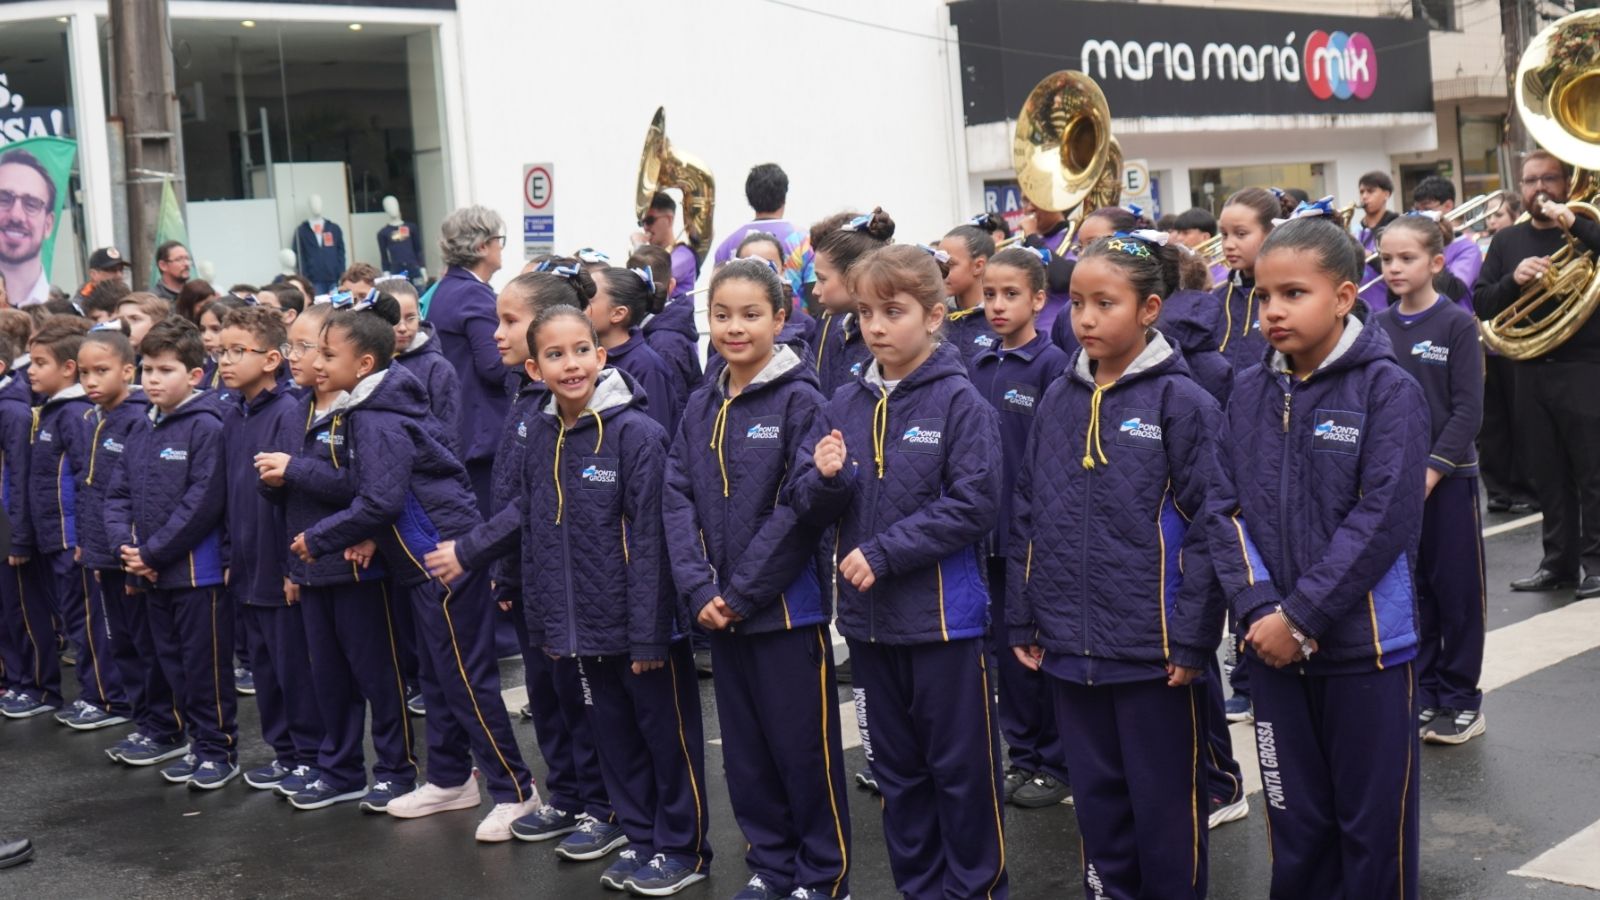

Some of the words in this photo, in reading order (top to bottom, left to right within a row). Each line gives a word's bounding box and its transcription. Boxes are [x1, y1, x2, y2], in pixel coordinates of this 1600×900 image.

[1081, 40, 1196, 81] maria
[1203, 31, 1300, 82] mariá
[1313, 45, 1369, 82] mix
[1127, 170, 1139, 189] E
[533, 176, 544, 200] E
[986, 189, 1023, 213] RA
[1429, 345, 1449, 355] PONTA
[1421, 352, 1447, 361] GROSSA
[917, 430, 941, 438] PONTA
[1129, 429, 1162, 440] GROSSA
[1331, 425, 1360, 437] PONTA
[909, 436, 939, 444] GROSSA
[1323, 433, 1357, 443] GROSSA
[594, 469, 617, 477] PONTA
[589, 475, 616, 483] GROSSA
[1256, 722, 1279, 768] GROSSA
[1263, 771, 1286, 810] PONTA
